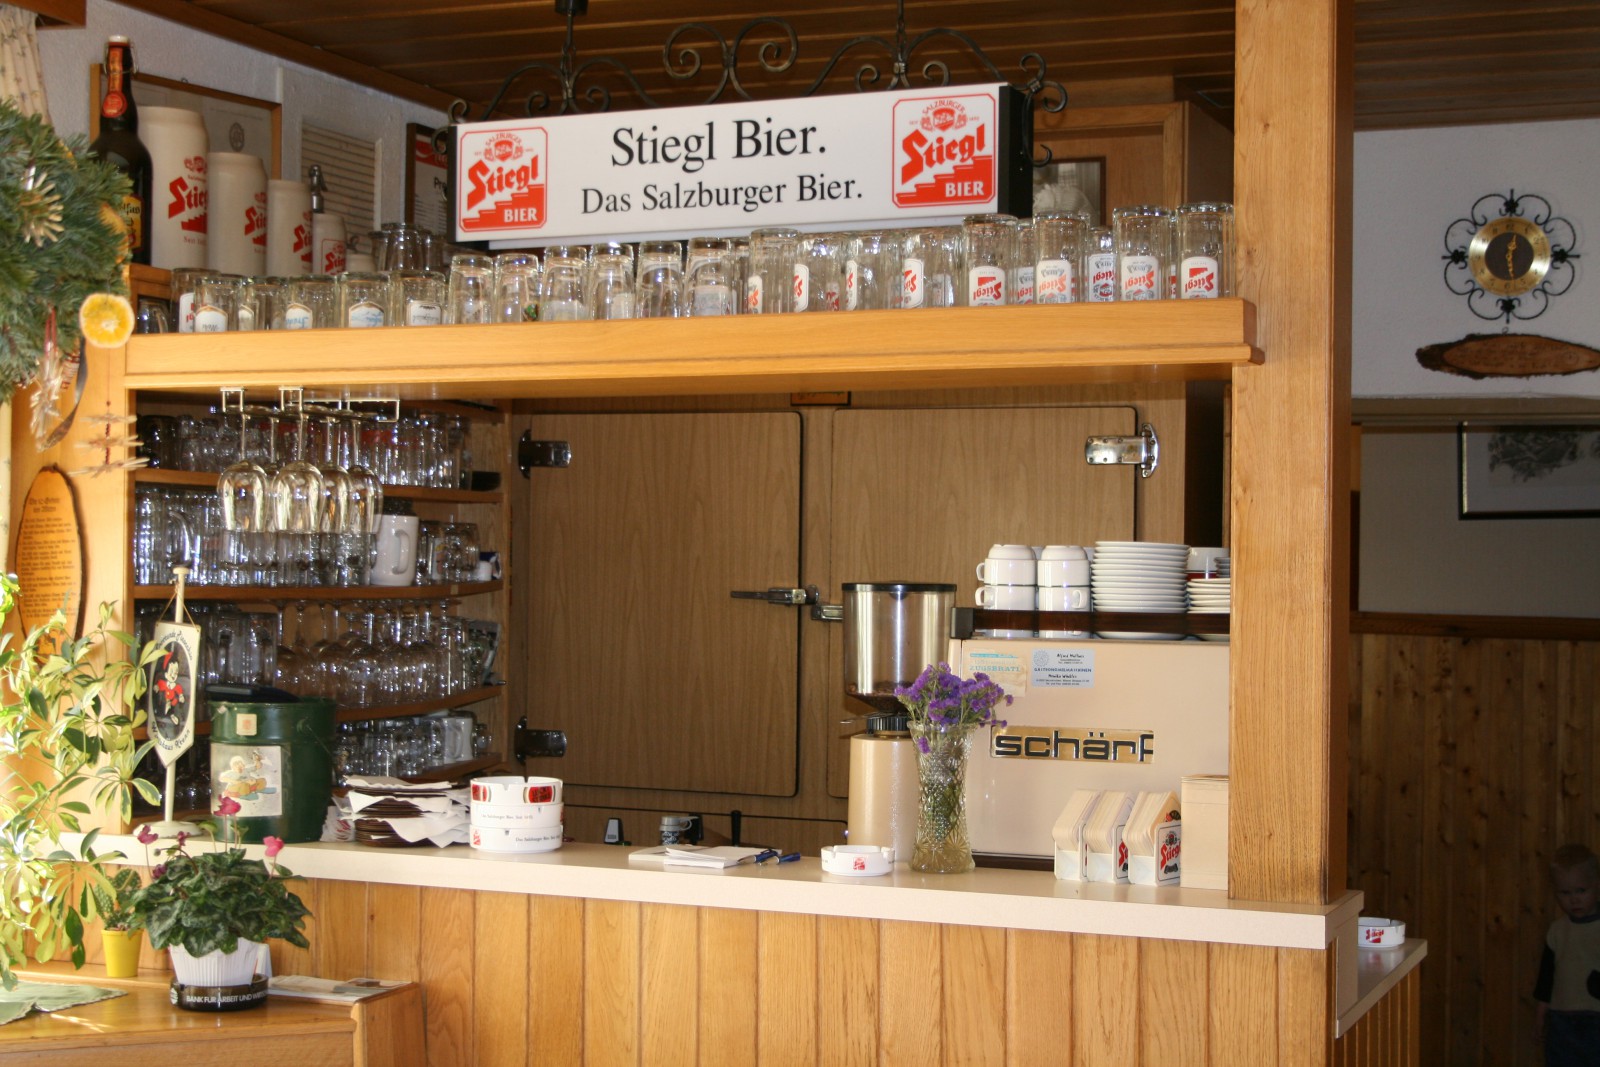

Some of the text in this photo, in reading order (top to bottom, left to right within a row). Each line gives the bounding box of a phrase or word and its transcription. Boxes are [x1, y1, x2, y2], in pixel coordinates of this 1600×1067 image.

[612, 117, 826, 174] Stiegl Bier.
[902, 124, 985, 185] Stiegl
[467, 154, 538, 211] Stiegl
[582, 174, 862, 214] Das Salzburger Bier.
[945, 181, 984, 197] BIER
[504, 207, 537, 223] BIER
[973, 281, 1001, 301] Stiegl
[1125, 270, 1154, 290] Stiegl
[1185, 272, 1214, 292] Stiegl
[995, 730, 1154, 762] schärf
